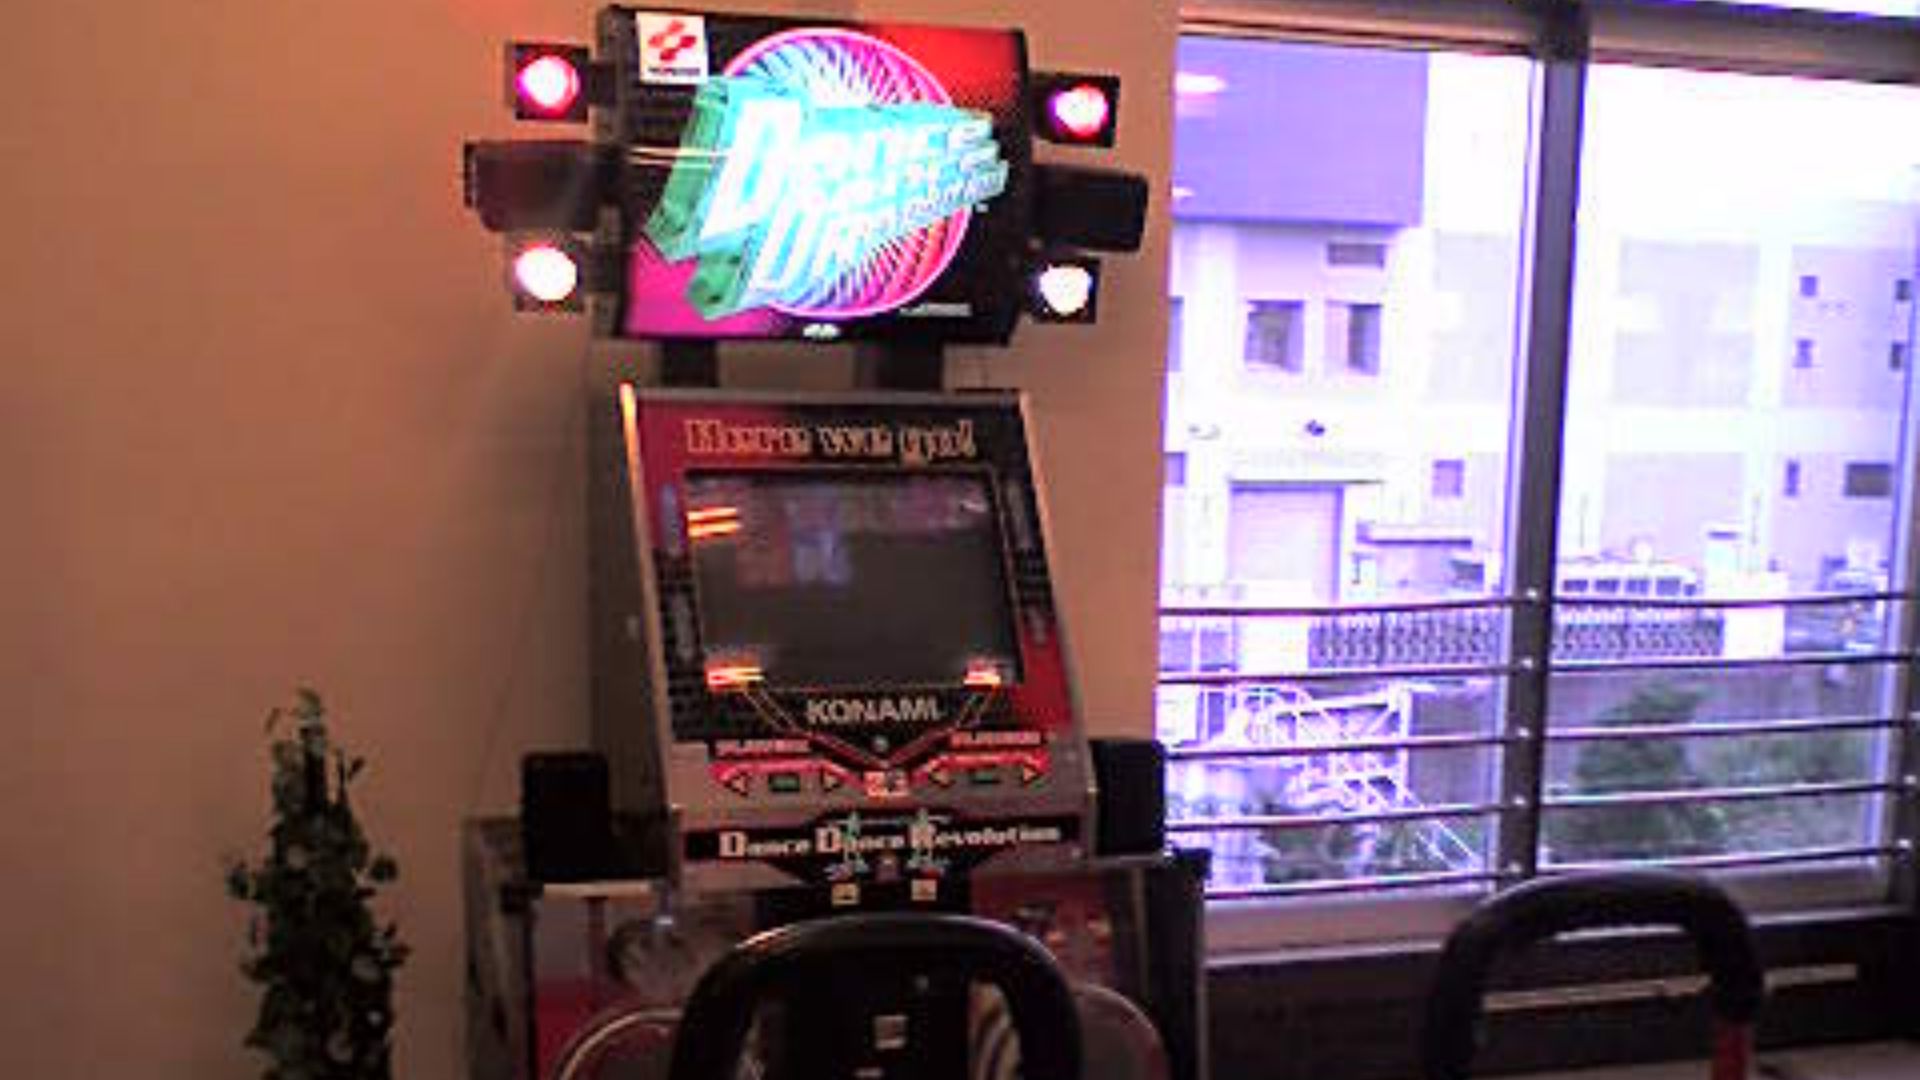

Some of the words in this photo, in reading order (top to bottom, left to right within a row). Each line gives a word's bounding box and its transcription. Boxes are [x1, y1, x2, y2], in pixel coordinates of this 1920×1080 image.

[807, 696, 940, 725] KONAMI
[718, 830, 812, 858] Dance
[910, 824, 1061, 850] Revolution
